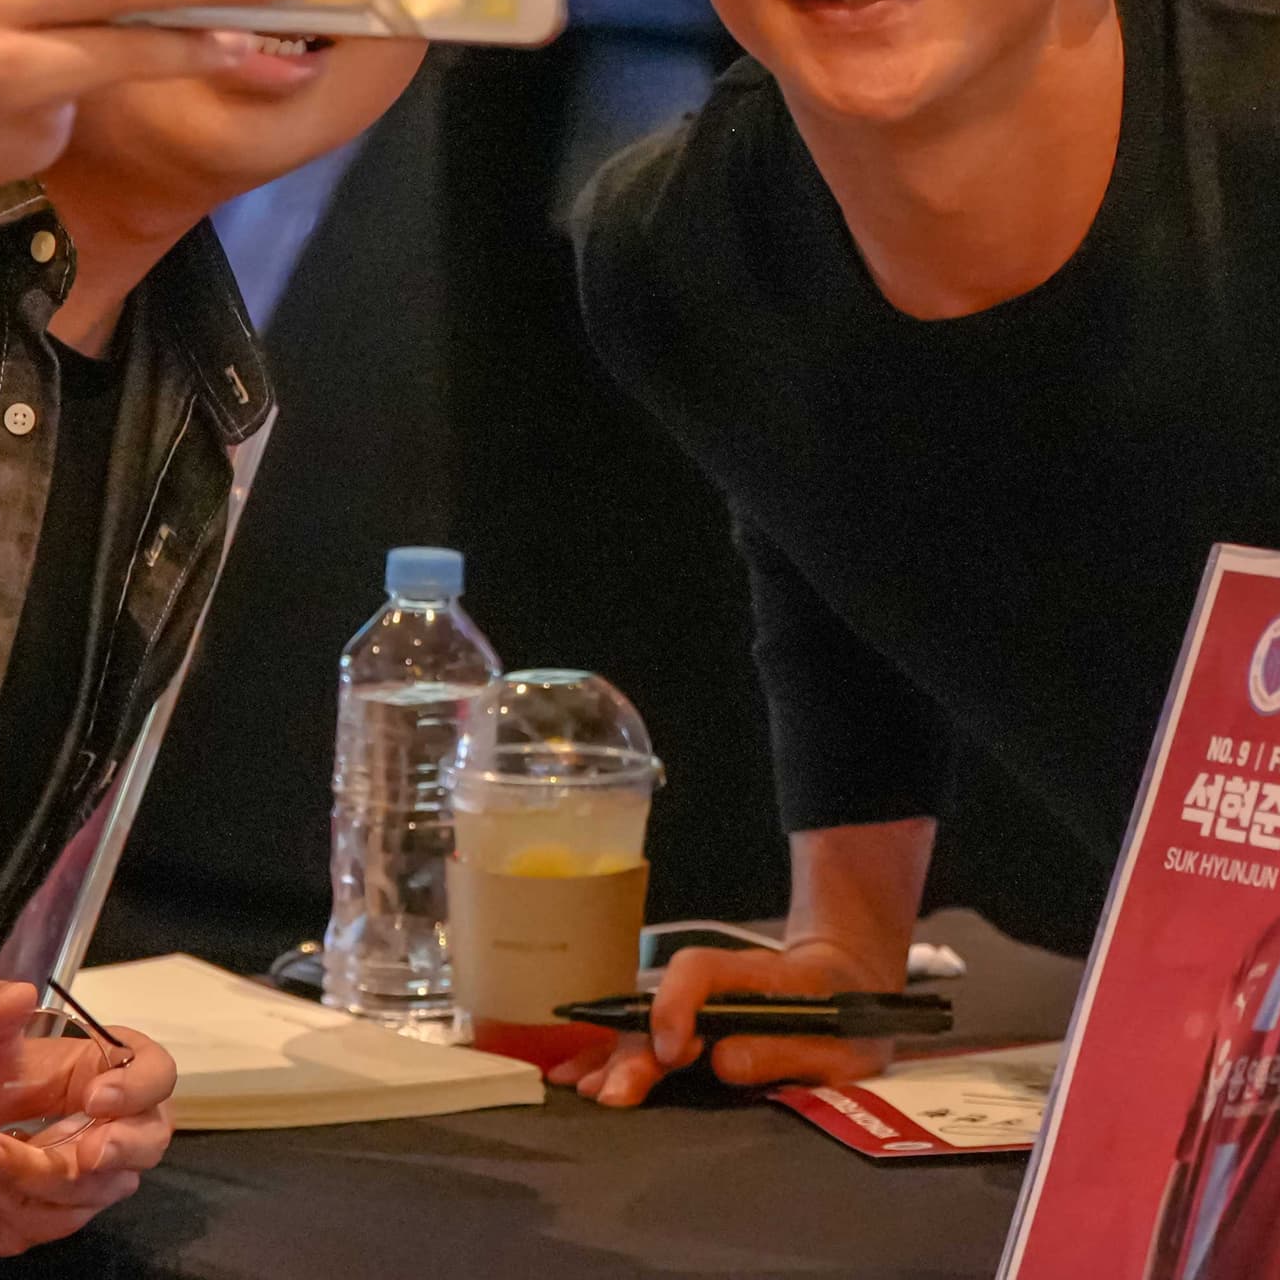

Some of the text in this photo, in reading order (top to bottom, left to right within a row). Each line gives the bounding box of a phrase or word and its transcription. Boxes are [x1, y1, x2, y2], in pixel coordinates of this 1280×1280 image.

[1206, 736, 1233, 764] NO.
[1236, 741, 1251, 767] 9
[1164, 846, 1280, 891] SUK HYUNJUN
